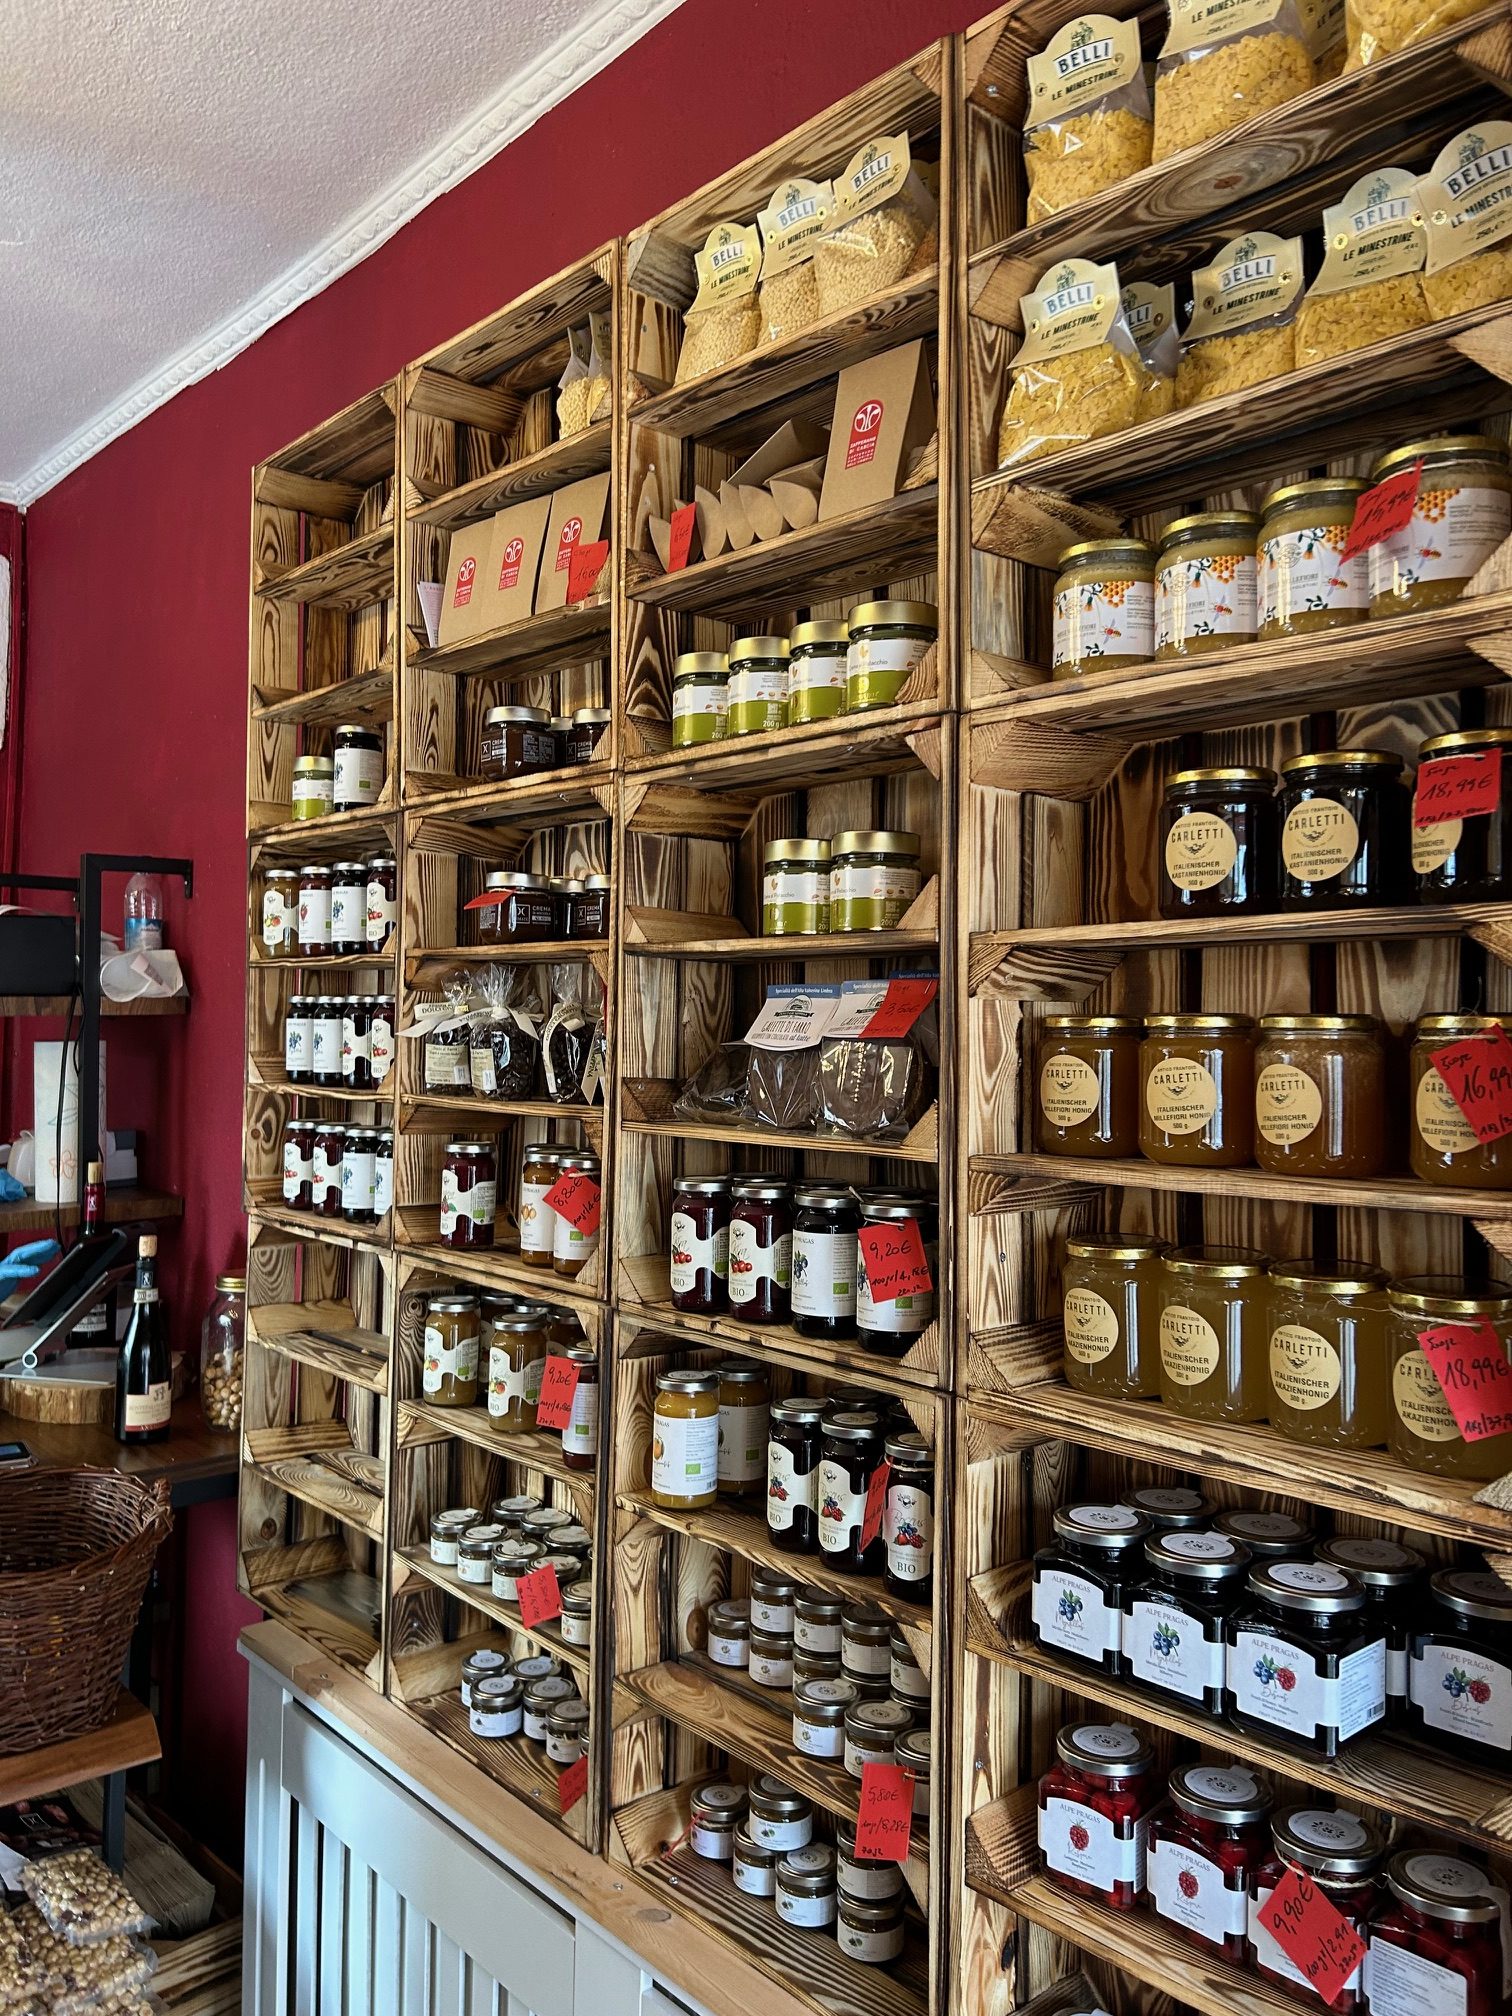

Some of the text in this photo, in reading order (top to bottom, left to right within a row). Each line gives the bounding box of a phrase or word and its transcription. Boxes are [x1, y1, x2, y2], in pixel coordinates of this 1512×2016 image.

[1192, 11, 1204, 24] LE
[1059, 42, 1110, 74] BELLI
[1052, 68, 1120, 101] LE MINESTRINE
[854, 156, 889, 192] BELLI
[1447, 150, 1511, 195] BELLI
[778, 200, 816, 226] BELLI
[1353, 200, 1406, 232] BELLI
[1450, 214, 1462, 229] LE
[778, 223, 824, 250] LE MINESTRINE
[1343, 231, 1415, 262] LE MINESTRINE
[713, 246, 744, 267] BELLI
[710, 266, 750, 289] LE MINESTRINE
[1221, 259, 1271, 287] BELLI
[1047, 286, 1092, 314] BELLI
[1212, 287, 1282, 316] LE MINESTRINE
[1041, 312, 1100, 339] LE MINESTRINE
[1288, 813, 1346, 832] CARLETTI
[1171, 828, 1224, 844] CARLETTI
[1289, 857, 1349, 869] KASTANIENHONIG
[1290, 848, 1342, 860] ITALIENISCHER
[1172, 869, 1226, 879] KASTANIENHONIG
[1173, 861, 1220, 870] ITALIENISCHER
[532, 904, 552, 912] CREMA
[1046, 1069, 1088, 1079] CARLETTI
[1154, 1071, 1203, 1085] CARLETTI
[1260, 1079, 1306, 1092] CARLETTI
[1156, 1104, 1205, 1112] ITALIENISCHER
[1262, 1114, 1308, 1122] ITALIENISCHER
[1290, 1122, 1314, 1130] HONIG
[869, 1240, 912, 1261] 9,20€
[673, 1277, 685, 1287] BIO
[731, 1287, 745, 1297] BIO
[1066, 1301, 1107, 1316] CARLETTI
[1162, 1318, 1206, 1336] CARLETTI
[1067, 1330, 1109, 1343] ITALIENISCHER
[1274, 1337, 1328, 1358] CARLETTI
[1163, 1349, 1210, 1365] ITALIENISCHER
[1164, 1359, 1210, 1374] AKAZIENHONIG
[1444, 1357, 1509, 1390] 18,99€
[549, 1366, 572, 1386] 9,20€
[1274, 1371, 1329, 1389] ITALIENISCHER
[1275, 1381, 1330, 1399] AKAZIENHONIG
[769, 1511, 782, 1524] BIO
[822, 1533, 837, 1545] BIO
[896, 1561, 917, 1574] BIO
[1052, 1575, 1091, 1593] ALPE PRAGAS
[1145, 1607, 1189, 1627] ALPE PRAGAS
[1252, 1639, 1300, 1660] ALPE PRAGAS
[1441, 1651, 1495, 1673] ALPE PRAGAS
[867, 1786, 900, 1805] 5,80€
[1060, 1803, 1101, 1825] ALPE PRAGAS
[1169, 1847, 1211, 1872] ALPE PRAGAS
[1273, 1881, 1314, 1936] 9,90€
